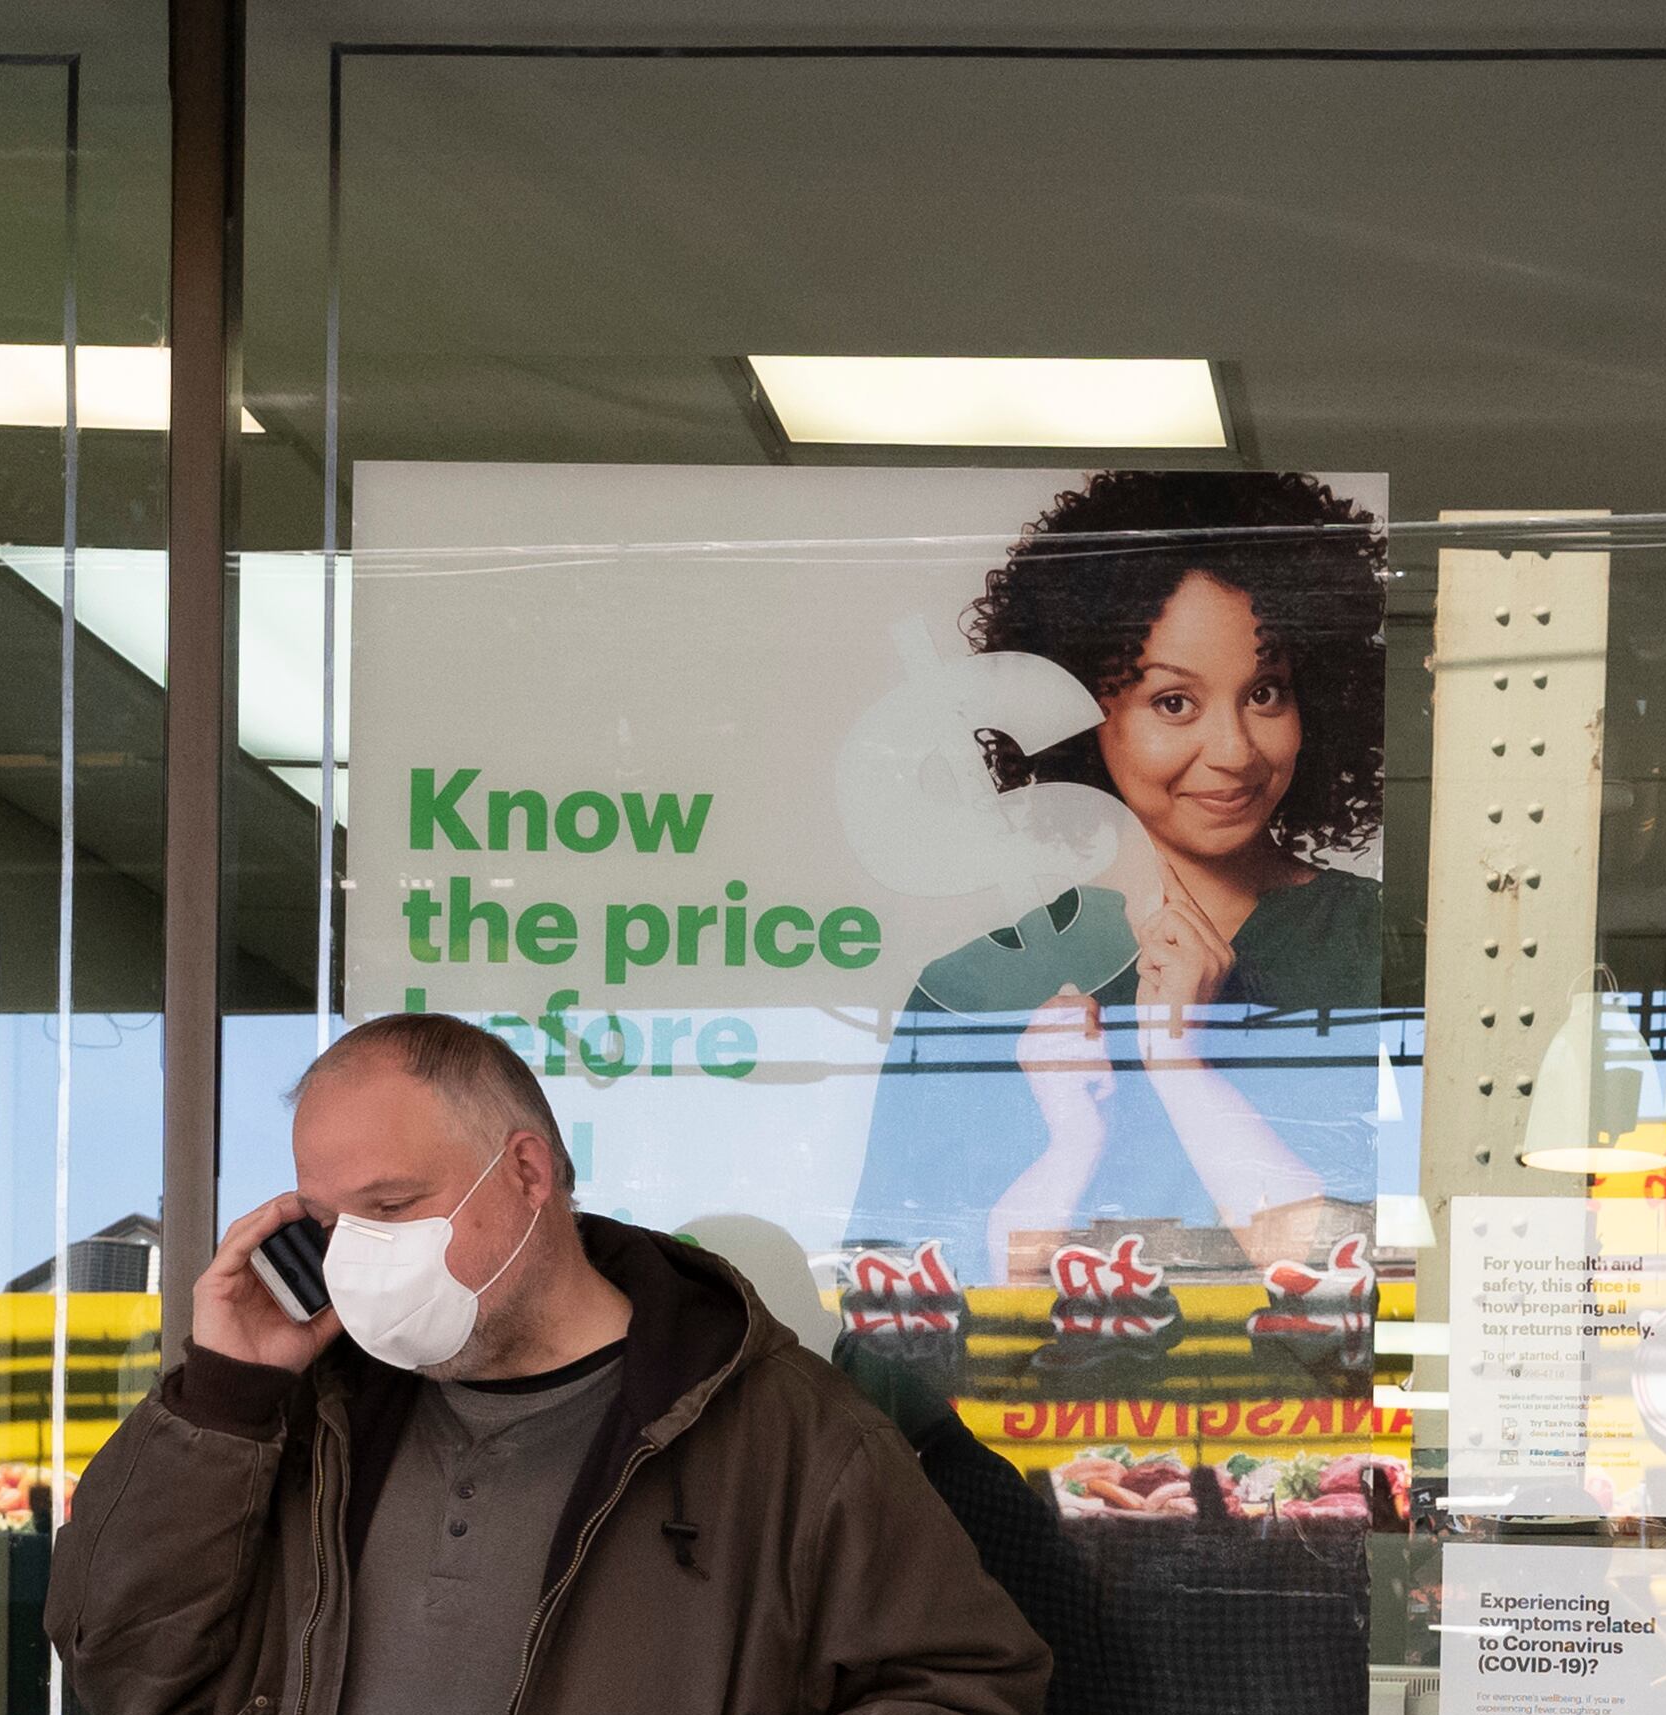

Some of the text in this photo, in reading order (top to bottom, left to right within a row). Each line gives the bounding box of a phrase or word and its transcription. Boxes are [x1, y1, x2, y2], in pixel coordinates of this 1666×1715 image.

[410, 768, 714, 854] Know
[402, 877, 881, 984] the price
[405, 988, 758, 1078] efore
[1484, 1256, 1643, 1273] For your health and
[1483, 1278, 1641, 1294] safety, this office is
[1482, 1300, 1627, 1316] now preparing all
[1482, 1322, 1655, 1339] tax returns remotely.
[1480, 1593, 1610, 1615] Experiencing
[1479, 1615, 1656, 1634] symptoms related
[1479, 1636, 1623, 1654] to Coronavirus
[1478, 1655, 1599, 1677] (COVID-19)?
[1476, 1692, 1490, 1700] For
[1594, 1697, 1609, 1705] you
[1559, 1706, 1601, 1715] coughing
